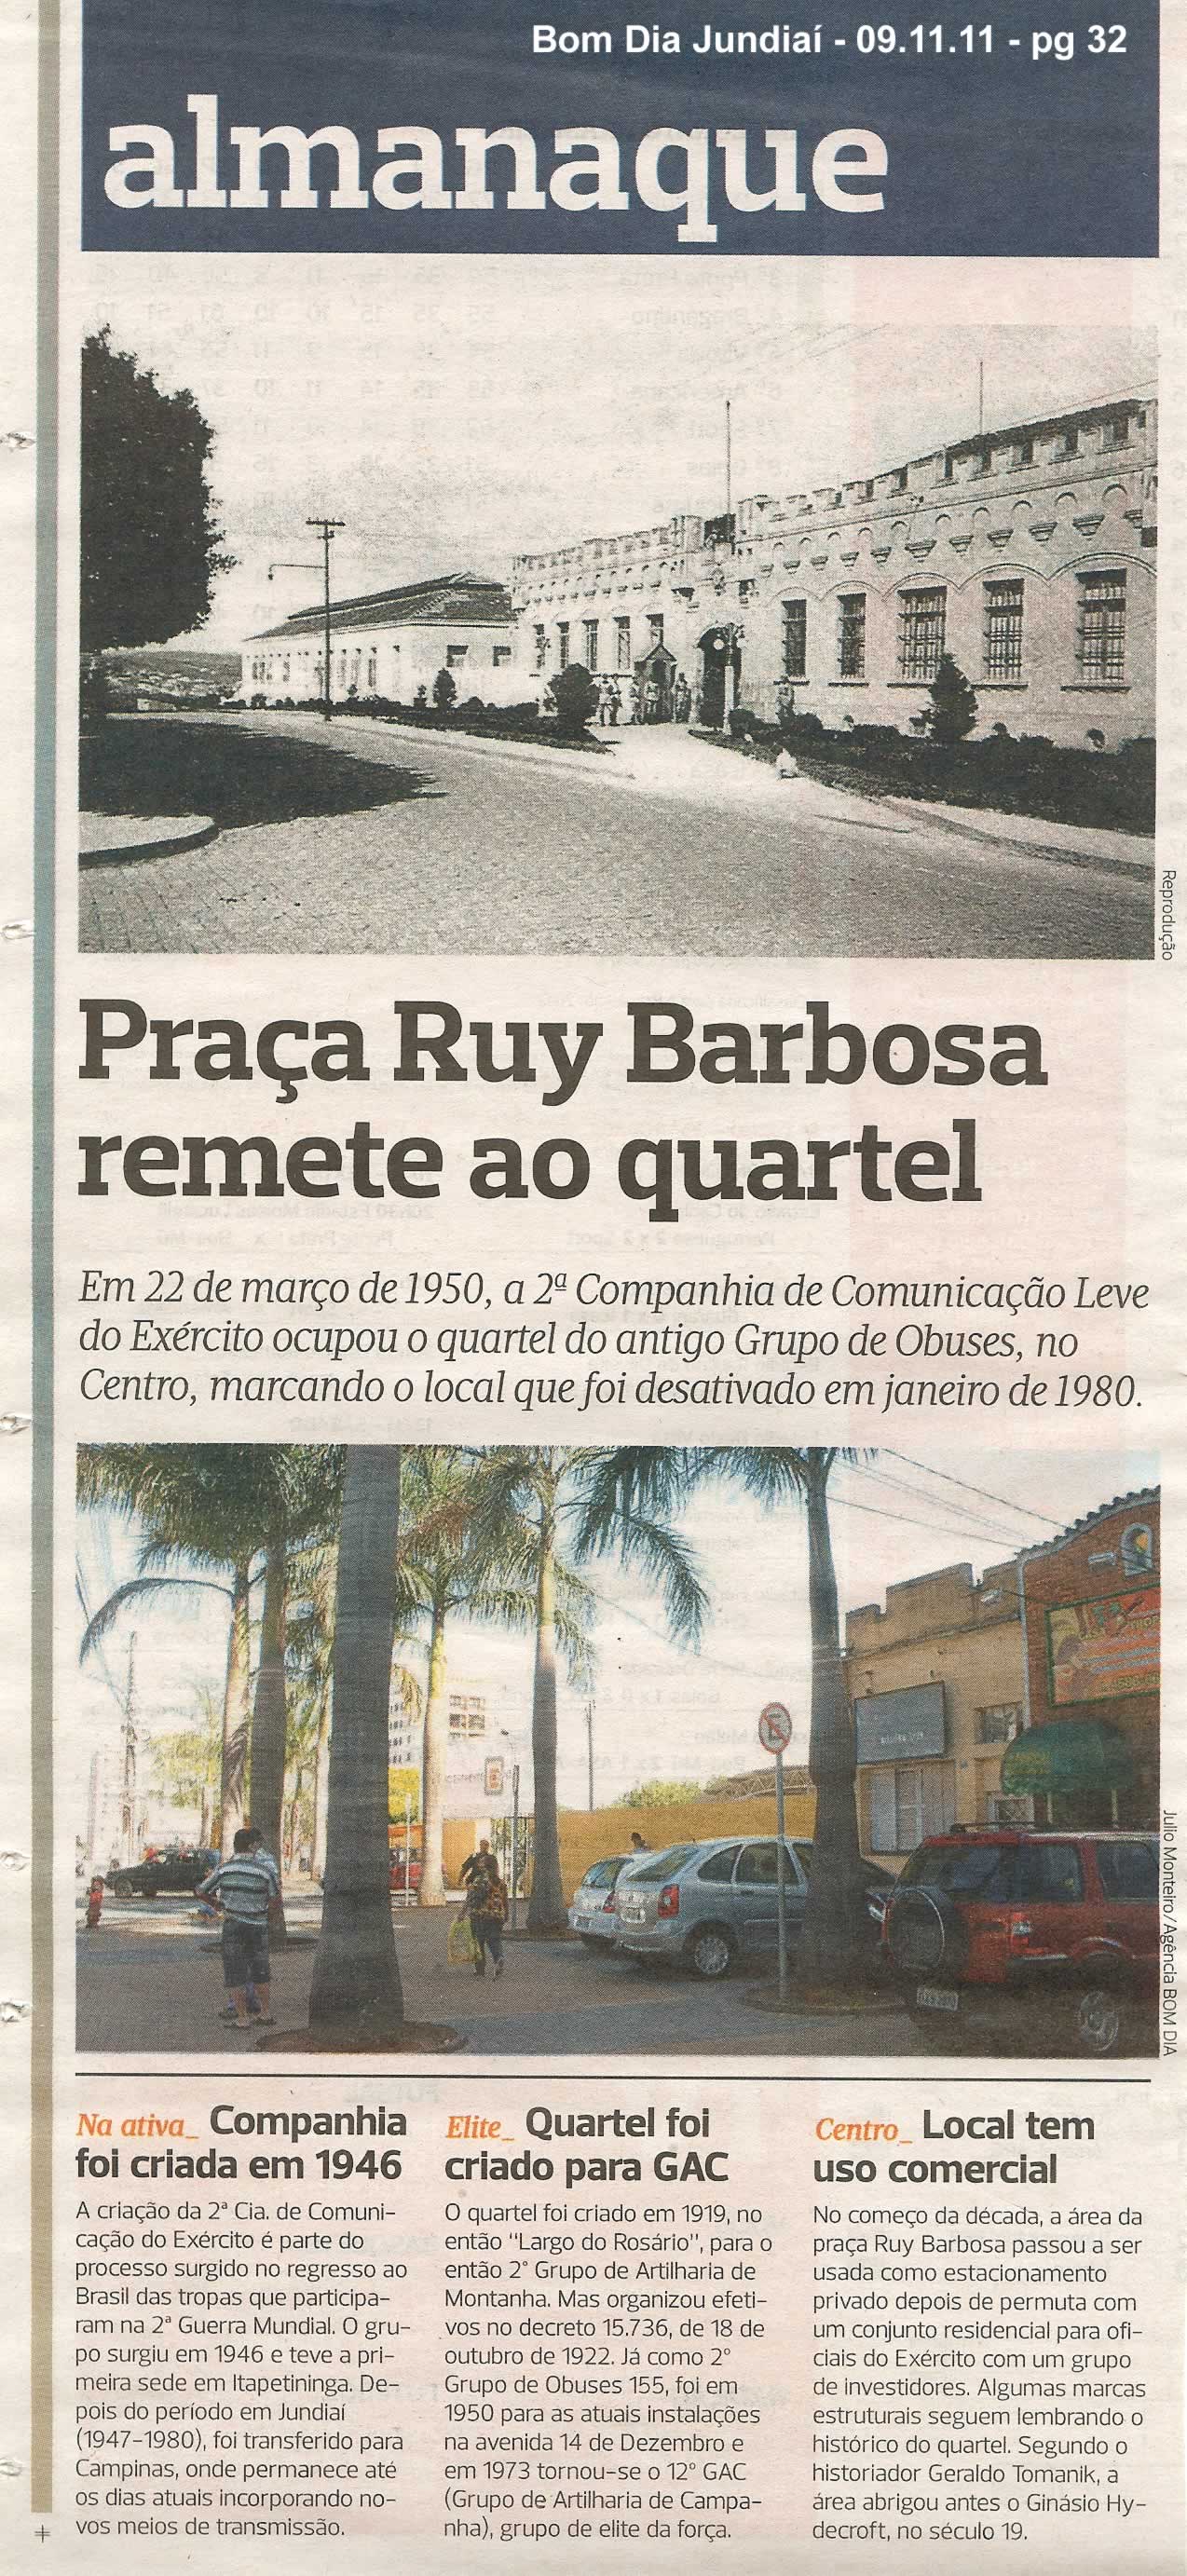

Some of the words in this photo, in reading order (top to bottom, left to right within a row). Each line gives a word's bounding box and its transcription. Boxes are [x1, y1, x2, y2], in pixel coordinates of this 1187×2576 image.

[103, 93, 889, 243] almanaque
[1158, 870, 1177, 961] Reprodução
[78, 998, 371, 1105] Praça
[393, 1001, 604, 1107] Ruy
[626, 1001, 1048, 1086] Barbosa
[77, 1121, 443, 1199] remete
[469, 1138, 591, 1200] ao
[618, 1118, 983, 1223] quartel
[77, 1270, 135, 1302] Em
[143, 1270, 184, 1302] 22
[193, 1269, 232, 1302] de
[241, 1278, 349, 1312] março
[359, 1271, 398, 1304] de
[404, 1272, 492, 1310] 1950,
[504, 1280, 525, 1305] a
[576, 1273, 774, 1314] Companhia
[784, 1273, 823, 1306] de
[831, 1274, 1066, 1316] Comunicação
[1073, 1276, 1150, 1309] Leve
[79, 1317, 121, 1351] do
[129, 1319, 264, 1353] Exército
[272, 1328, 398, 1361] ocupou
[407, 1329, 428, 1353] o
[437, 1321, 556, 1362] quartel
[565, 1321, 607, 1355] do
[616, 1322, 725, 1363] antigo
[734, 1323, 839, 1364] Grupo
[848, 1323, 887, 1356] de
[895, 1323, 1023, 1363] Obuses,
[1036, 1333, 1078, 1357] no
[80, 1368, 197, 1407] Centro,
[210, 1369, 385, 1402] marcando
[393, 1378, 414, 1402] o
[425, 1370, 506, 1403] local
[514, 1377, 575, 1411] que
[578, 1370, 627, 1411] foi
[634, 1370, 815, 1405] desativado
[825, 1381, 875, 1406] em
[881, 1373, 1000, 1414] janeiro
[1008, 1373, 1048, 1407] de
[1054, 1374, 1141, 1407] 1980.
[1163, 1810, 1178, 1842] Julio
[1162, 1988, 1178, 2025] BOM
[1163, 2031, 1178, 2056] DIA
[75, 2112, 114, 2138] Na
[210, 2104, 407, 2144] Companhia
[525, 2106, 655, 2141] Quartel
[665, 2106, 710, 2138] foi
[923, 2108, 1015, 2140] Local
[1025, 2111, 1095, 2140] tem
[75, 2147, 119, 2178] foi
[130, 2147, 238, 2179] criada
[249, 2156, 304, 2179] em
[315, 2148, 402, 2180] 1946
[444, 2149, 554, 2181] criado
[566, 2158, 642, 2189] para
[653, 2150, 730, 2182] GAC
[813, 2160, 877, 2183] uso
[888, 2153, 1057, 2184] comercial
[75, 2201, 90, 2219] A
[97, 2201, 171, 2225] criação
[177, 2201, 201, 2220] da
[234, 2201, 269, 2220] Cia.
[276, 2201, 302, 2221] de
[308, 2201, 396, 2221] Comuni-
[444, 2202, 461, 2222] O
[468, 2203, 537, 2227] quartel
[542, 2202, 567, 2222] foi
[574, 2203, 636, 2223] criado
[643, 2208, 675, 2223] em
[681, 2204, 730, 2226] 1919,
[737, 2209, 762, 2223] no
[813, 2205, 841, 2224] No
[848, 2209, 928, 2229] começo
[935, 2205, 959, 2225] da
[965, 2205, 1044, 2228] década,
[1050, 2211, 1061, 2225] a
[1068, 2207, 1112, 2226] área
[1118, 2206, 1142, 2226] da
[75, 2262, 168, 2281] processo
[174, 2258, 249, 2282] surgido
[255, 2263, 280, 2278] no
[287, 2263, 376, 2283] regresso
[383, 2264, 408, 2279] ao
[445, 2288, 551, 2308] Montanha.
[558, 2289, 600, 2309] Mas
[607, 2290, 705, 2313] organizou
[712, 2290, 768, 2310] efeti-
[444, 2322, 481, 2337] vos
[487, 2322, 512, 2337] no
[519, 2317, 596, 2337] decreto
[603, 2318, 673, 2340] 15.736,
[679, 2318, 704, 2337] de
[710, 2319, 733, 2337] 18
[740, 2319, 765, 2337] de
[813, 2324, 845, 2338] um
[852, 2320, 937, 2343] conjunto
[944, 2321, 1050, 2339] residencial
[1057, 2325, 1100, 2344] para
[1107, 2321, 1143, 2340] ofi-
[813, 2377, 838, 2395] de
[844, 2377, 970, 2396] investidores.
[976, 2378, 1066, 2402] Algumas
[1072, 2382, 1146, 2398] marcas
[444, 2403, 494, 2422] 1950
[501, 2407, 544, 2427] para
[551, 2408, 574, 2423] as
[580, 2405, 641, 2423] atuais
[648, 2405, 760, 2428] instalações
[76, 2426, 207, 2453] (1947-1980),
[212, 2430, 238, 2449] foi
[243, 2431, 353, 2450] transferido
[360, 2435, 403, 2455] para
[812, 2433, 899, 2454] histórico
[906, 2434, 931, 2454] do
[937, 2435, 1011, 2459] quartel.
[1018, 2435, 1109, 2460] Segundo
[1115, 2440, 1128, 2455] o
[444, 2465, 476, 2480] em
[483, 2460, 530, 2480] 1973
[537, 2462, 641, 2481] tornou-se
[648, 2466, 661, 2481] o
[703, 2462, 746, 2481] GAC
[812, 2496, 856, 2511] área
[863, 2492, 938, 2515] abrigou
[945, 2494, 1001, 2512] antes
[1007, 2497, 1020, 2512] o
[1027, 2493, 1099, 2513] Ginásio
[1107, 2494, 1147, 2517] Hy-
[444, 2515, 493, 2541] nha),
[499, 2523, 561, 2542] grupo
[567, 2518, 593, 2538] de
[599, 2519, 640, 2538] elite
[647, 2519, 671, 2538] da
[676, 2519, 731, 2543] força.
